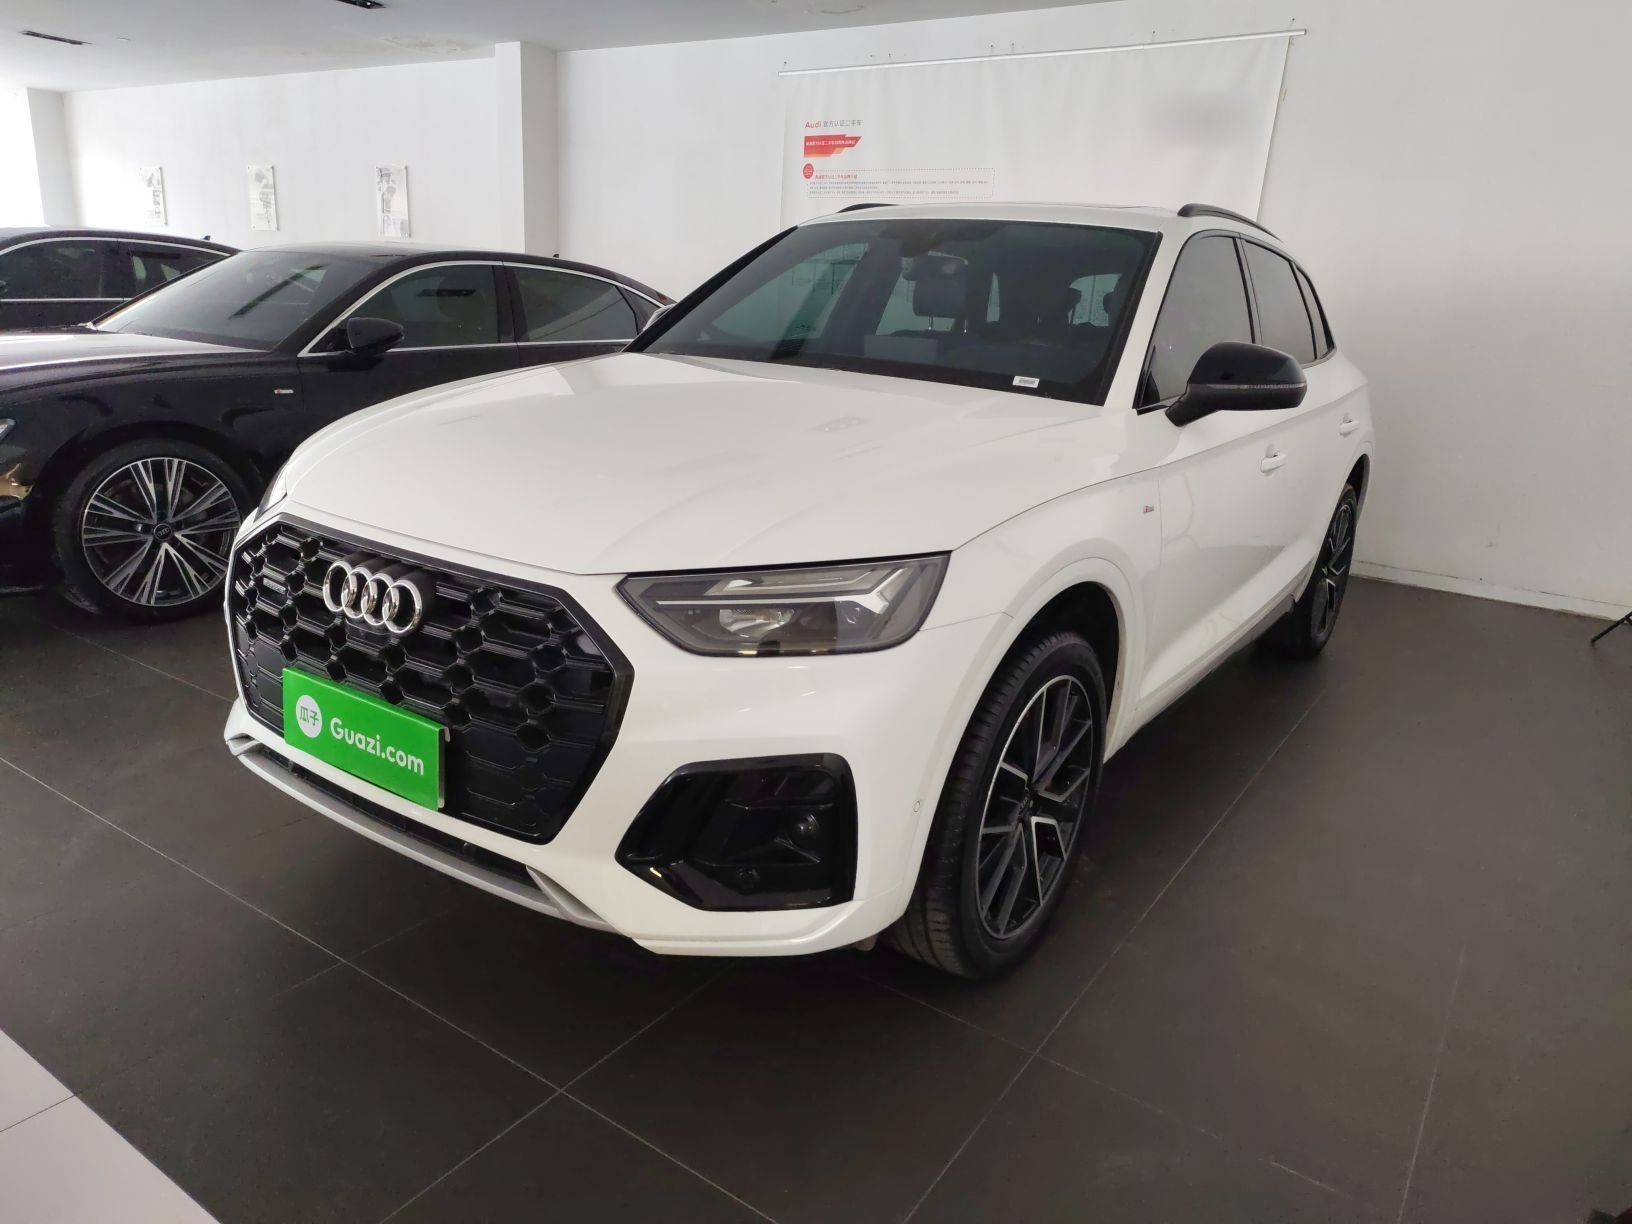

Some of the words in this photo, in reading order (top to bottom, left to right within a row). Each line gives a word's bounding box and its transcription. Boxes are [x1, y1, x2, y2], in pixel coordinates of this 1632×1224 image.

[805, 121, 821, 129] Audi
[299, 705, 320, 726] 瓜子
[330, 717, 424, 776] Guazi.com
